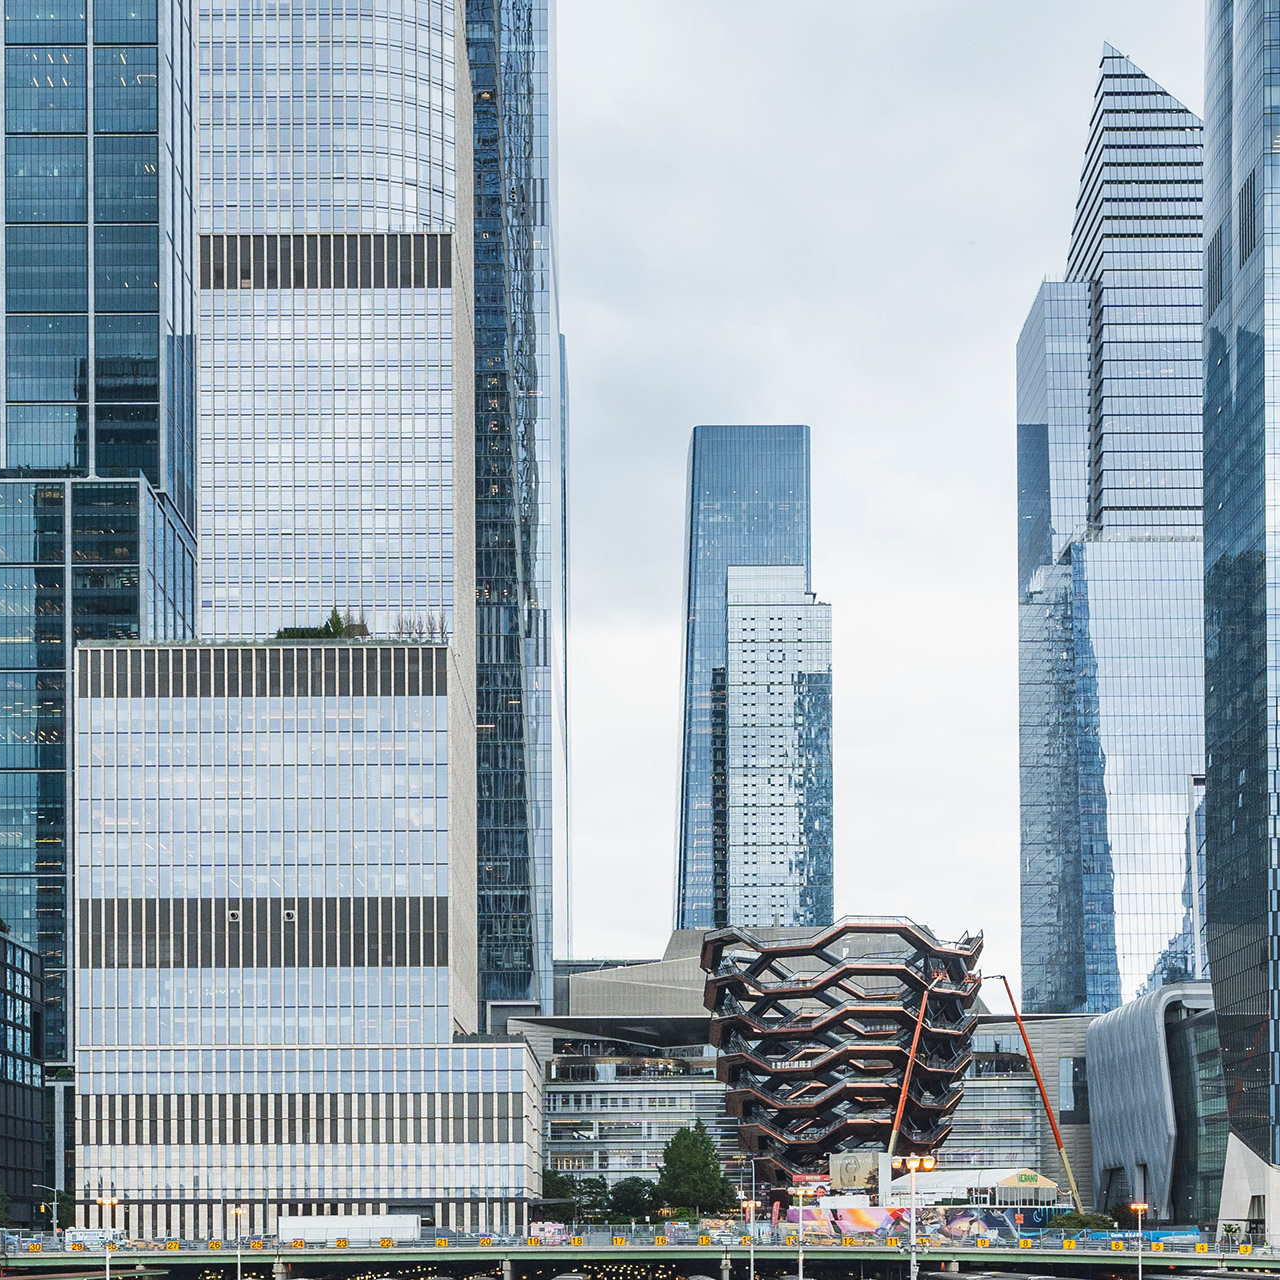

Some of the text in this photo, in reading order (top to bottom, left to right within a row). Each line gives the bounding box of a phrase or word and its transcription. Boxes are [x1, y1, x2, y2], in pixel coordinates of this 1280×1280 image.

[210, 1241, 220, 1249] 26
[336, 1240, 347, 1248] 23
[529, 1237, 539, 1245] 19
[1023, 1239, 1028, 1247] 8
[1067, 1241, 1072, 1249] 7
